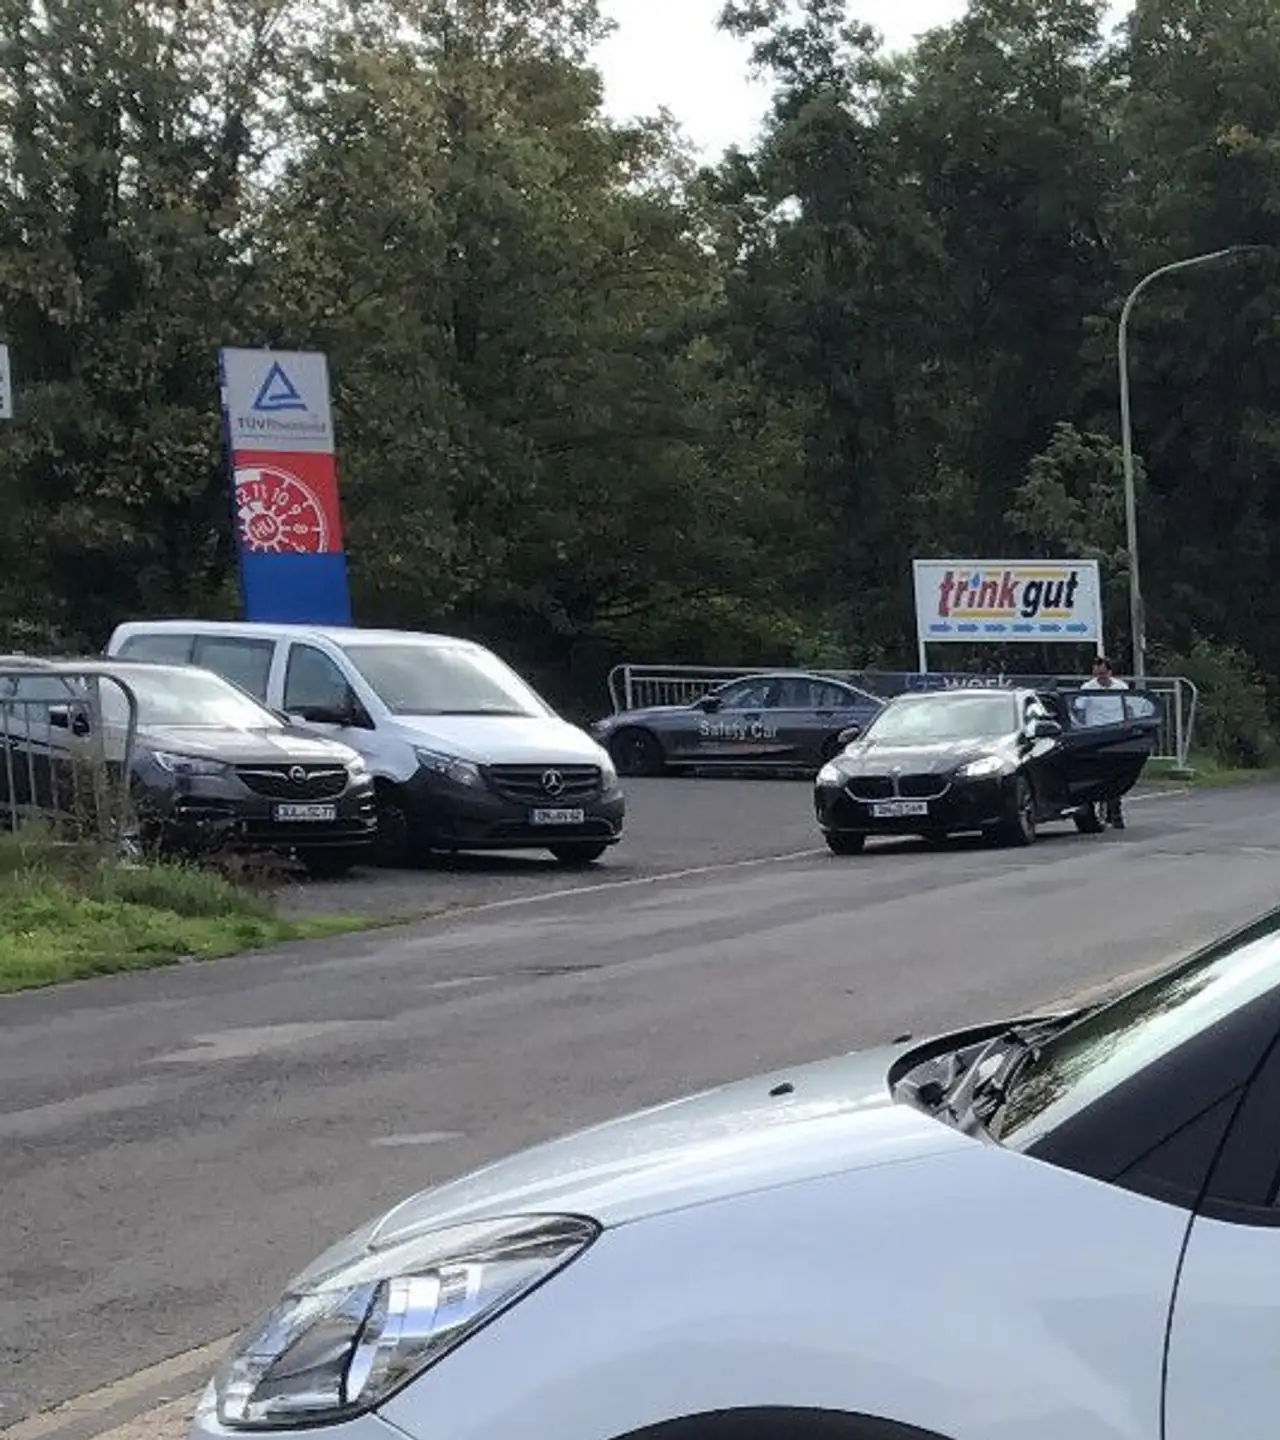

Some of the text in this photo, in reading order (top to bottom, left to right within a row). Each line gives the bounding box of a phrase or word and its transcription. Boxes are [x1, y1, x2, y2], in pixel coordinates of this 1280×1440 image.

[271, 487, 290, 506] 10
[938, 571, 1079, 618] trink gut
[751, 721, 777, 738] Car
